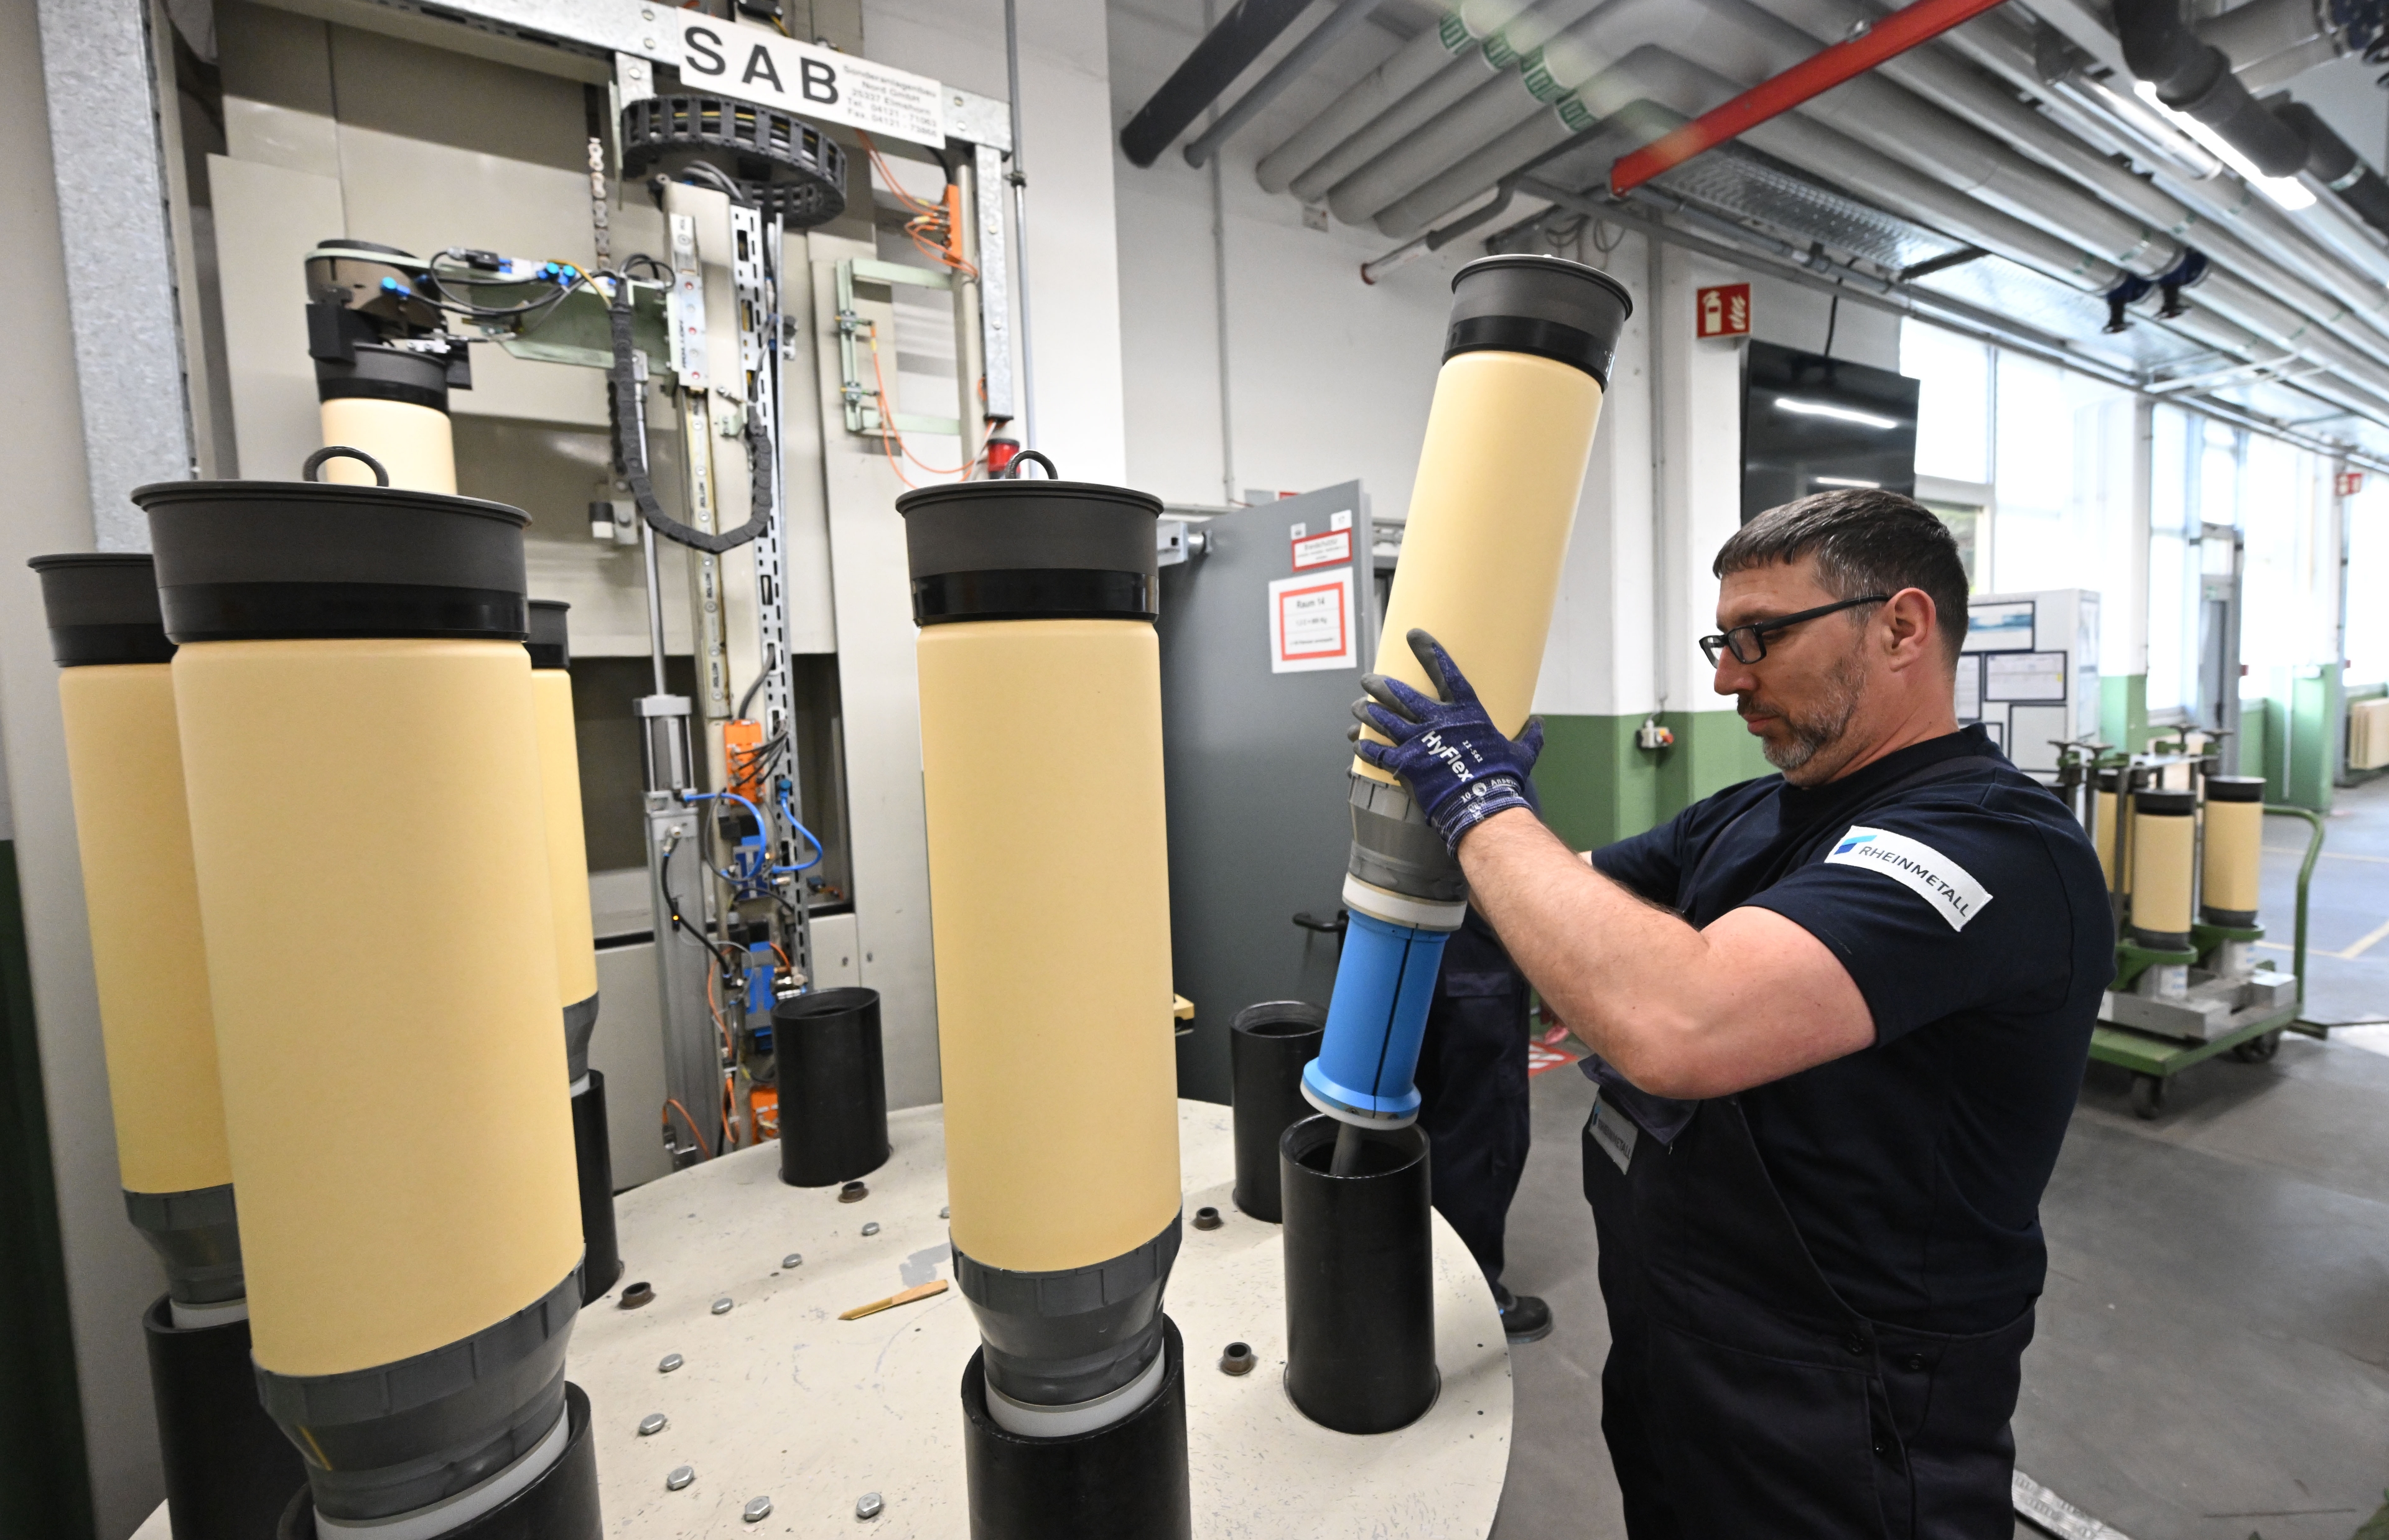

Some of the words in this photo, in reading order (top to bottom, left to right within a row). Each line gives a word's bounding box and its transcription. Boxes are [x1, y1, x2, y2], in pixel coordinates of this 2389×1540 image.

[684, 26, 839, 104] SAB
[1421, 730, 1474, 782] HyFlex
[1462, 740, 1483, 763] 11-561
[1461, 792, 1471, 803] 10
[1858, 846, 1969, 918] RHEINMETALL
